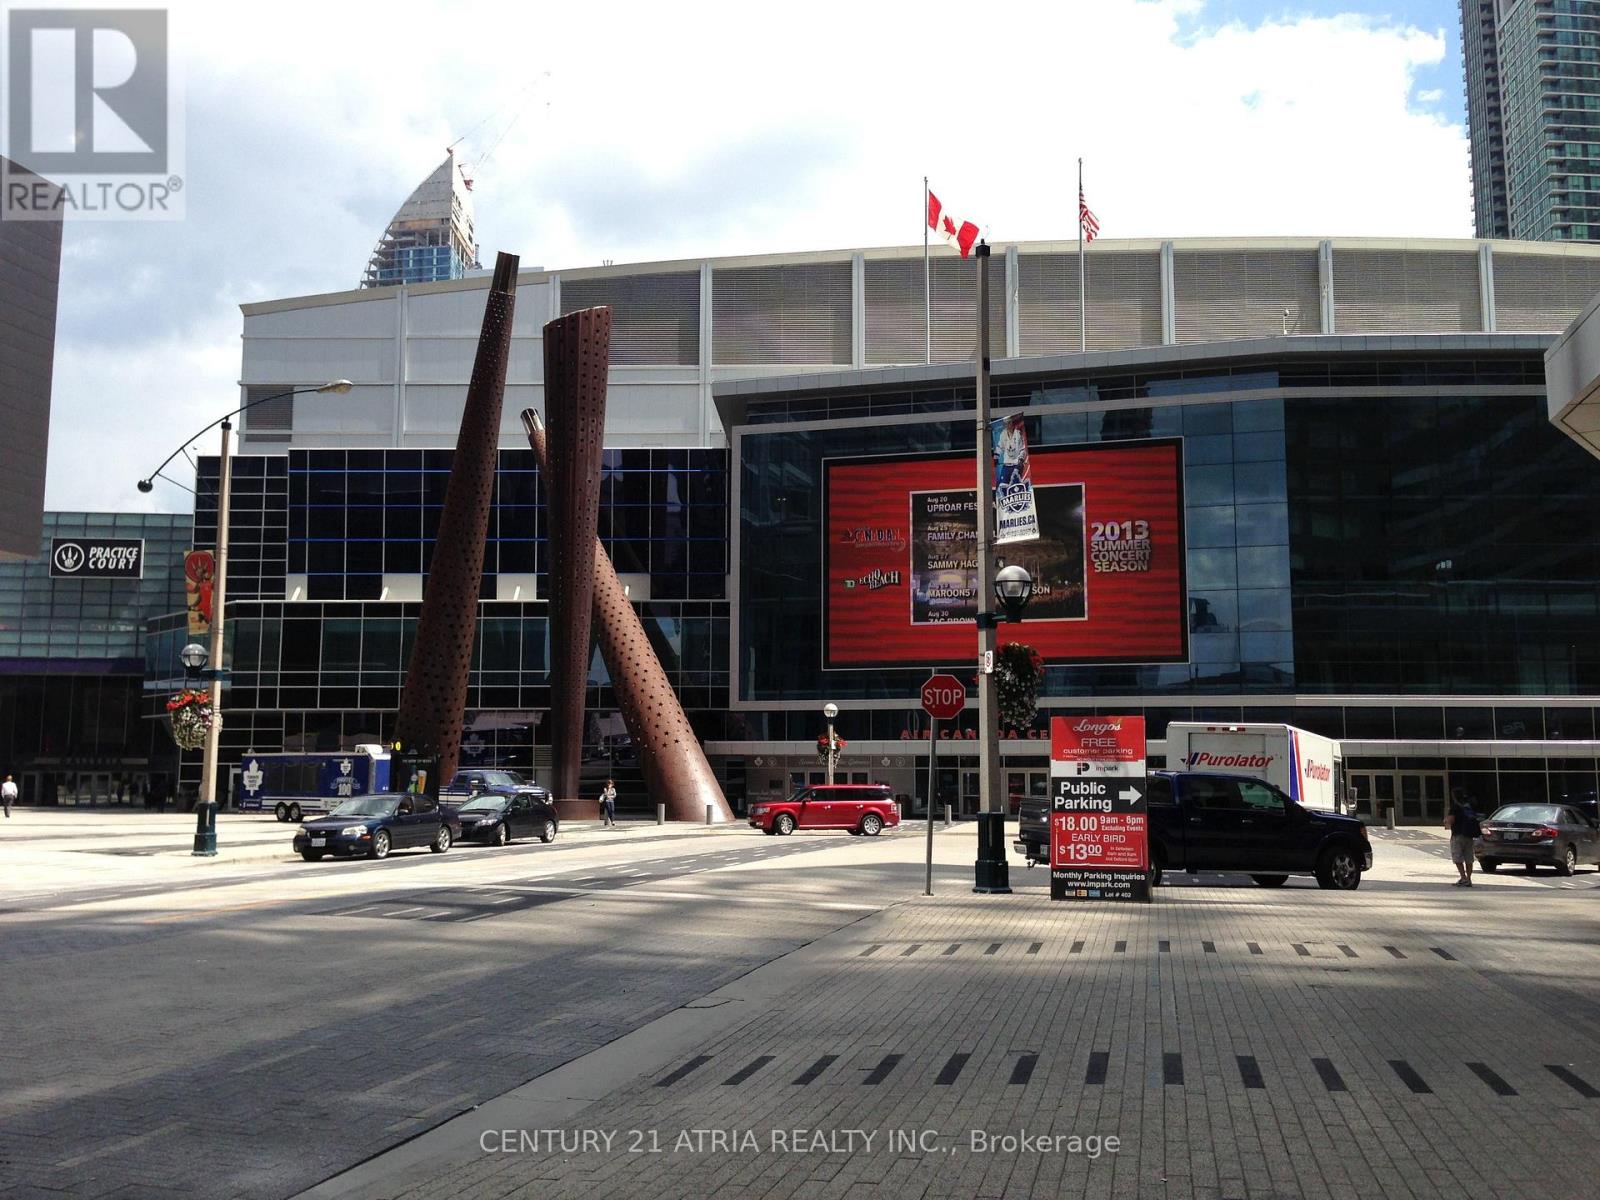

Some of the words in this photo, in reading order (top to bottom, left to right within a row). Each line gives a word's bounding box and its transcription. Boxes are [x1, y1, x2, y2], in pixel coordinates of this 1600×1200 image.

[927, 496, 939, 504] Aug
[1002, 493, 1032, 506] MARLIES
[927, 502, 962, 512] UPROAR
[1000, 514, 1036, 529] MARLIES.CA
[927, 532, 956, 541] FAMILY
[1091, 520, 1149, 541] 2013
[89, 546, 139, 559] PRACTICE
[1091, 540, 1151, 552] SUMMER
[1091, 550, 1152, 562] CONCERT
[88, 558, 136, 570] COURT
[927, 560, 959, 570] SAMMY
[960, 560, 978, 568] HAG
[1094, 560, 1148, 573] SEASON
[859, 568, 881, 585] ECHO
[869, 570, 899, 590] BEACH
[927, 588, 970, 598] MAROON5
[928, 610, 940, 618] Aug
[924, 688, 962, 705] STOP
[1073, 718, 1122, 735] Longo's
[900, 729, 932, 740] AIR
[940, 729, 1018, 740] CANDA
[1081, 738, 1117, 747] FREE
[1197, 752, 1274, 768] Purolator
[1309, 760, 1331, 782] Purolator
[1060, 781, 1107, 795] Public
[1054, 797, 1112, 812] Parking
[1054, 816, 1098, 831] $18.00
[1100, 816, 1118, 826] 9am
[1071, 834, 1101, 842] EARLY
[1103, 835, 1126, 843] BIRD
[1053, 871, 1083, 880] Monthly
[1083, 872, 1112, 881] Parking
[1113, 872, 1145, 881] Inquiries
